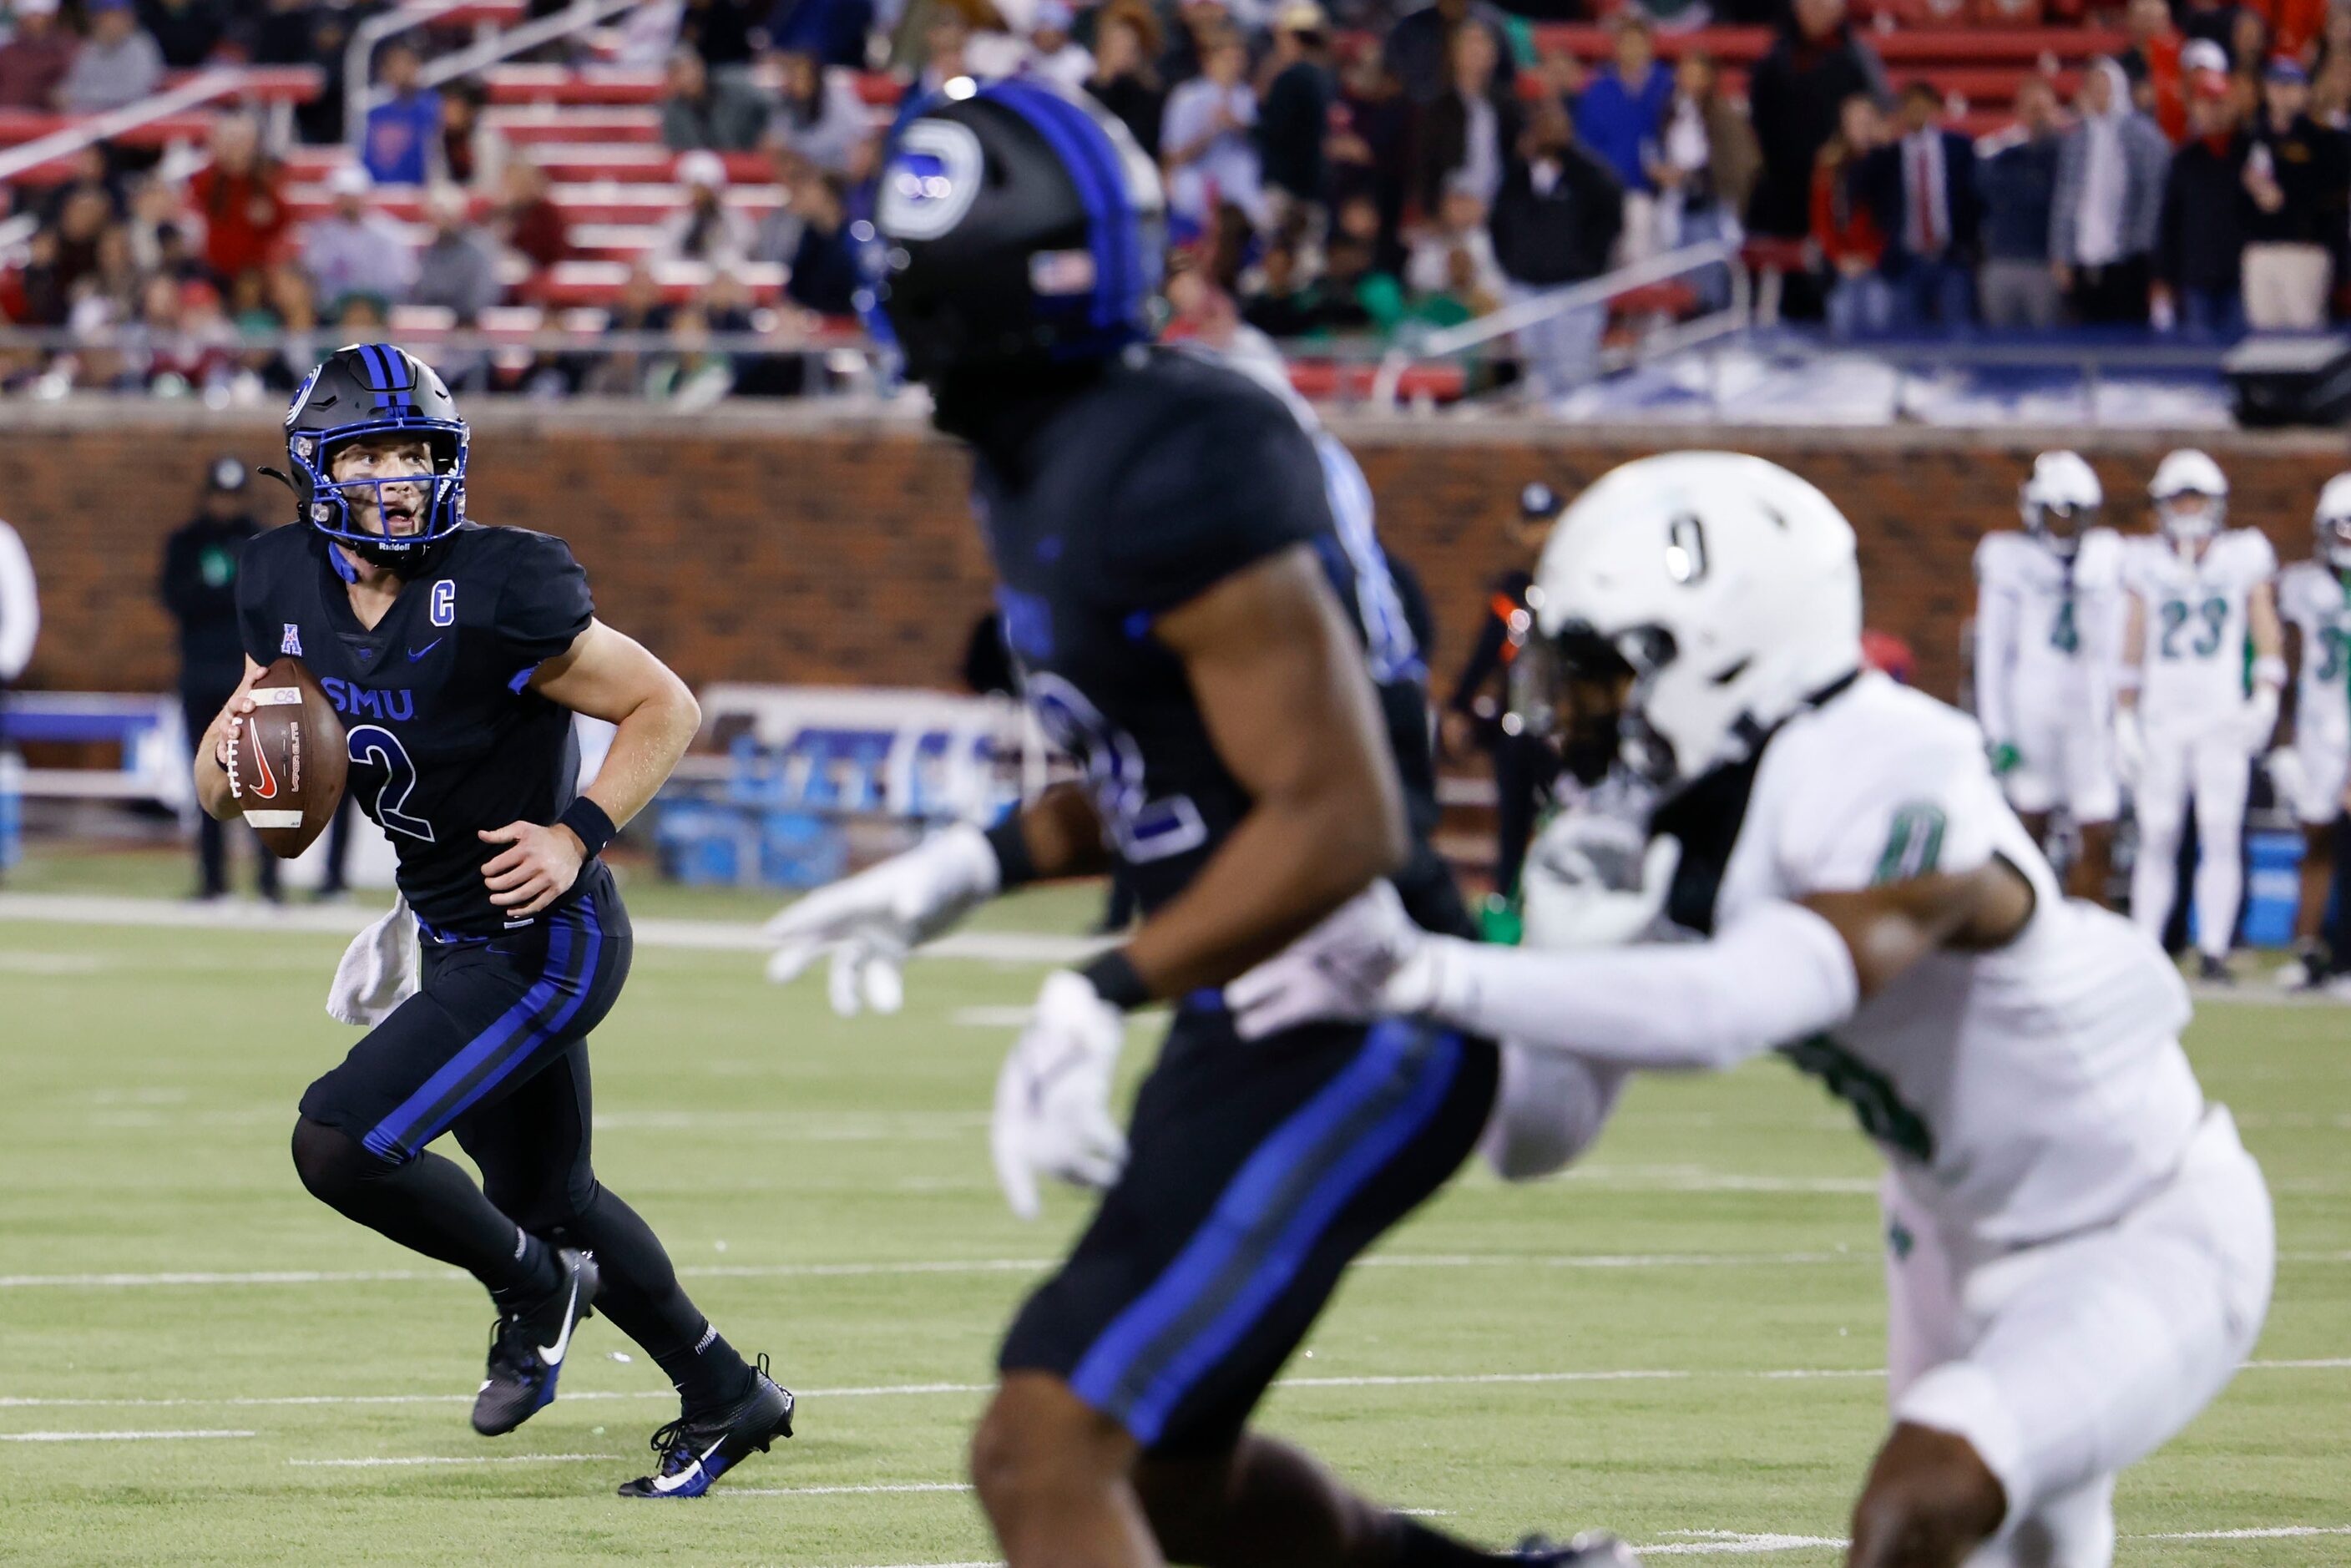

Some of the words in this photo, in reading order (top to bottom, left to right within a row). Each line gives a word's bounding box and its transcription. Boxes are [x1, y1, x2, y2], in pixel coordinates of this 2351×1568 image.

[379, 543, 410, 552] Riddell
[430, 579, 456, 627] C
[281, 624, 302, 656] A
[2161, 595, 2227, 659] 23
[321, 676, 414, 721] SMU
[291, 721, 300, 754] ELITE
[291, 755, 300, 792] VAPOR
[346, 725, 435, 842] 2
